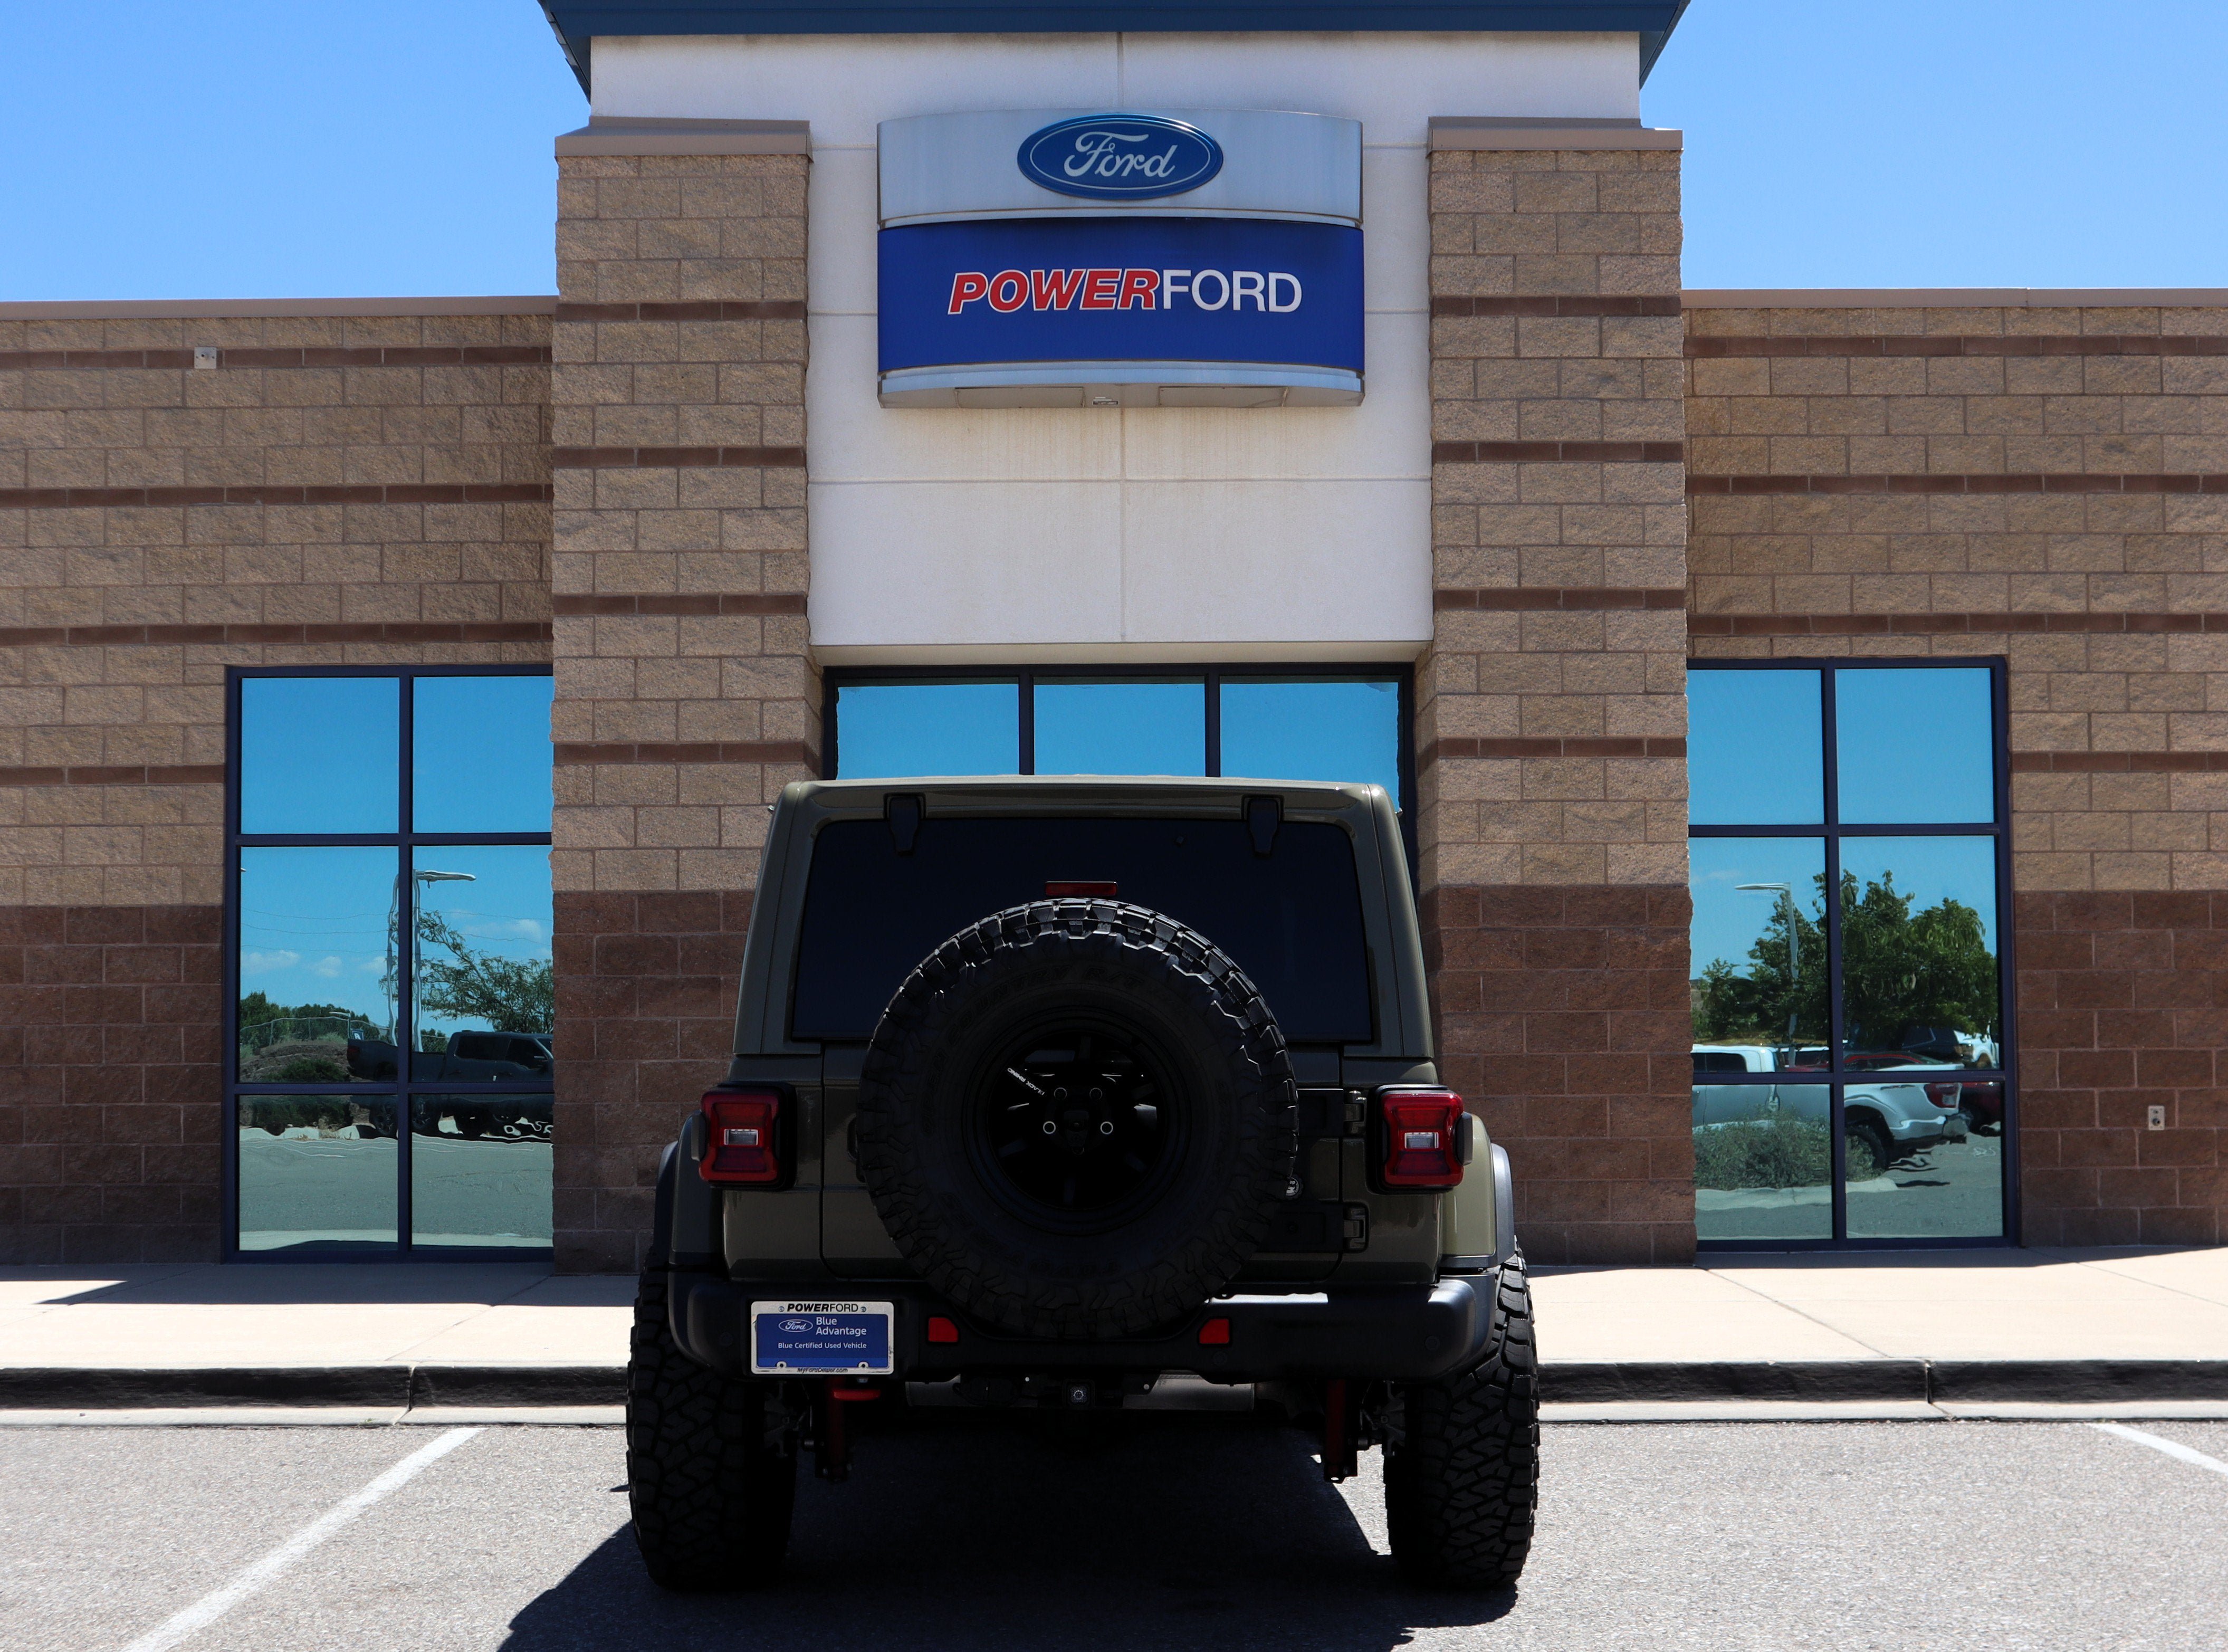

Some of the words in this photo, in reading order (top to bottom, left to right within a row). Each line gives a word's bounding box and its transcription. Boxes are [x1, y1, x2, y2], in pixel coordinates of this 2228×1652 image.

[1064, 131, 1176, 177] Ford
[1007, 1067, 1026, 1082] RHINO
[1026, 1081, 1045, 1095] BLACK
[785, 1321, 807, 1330] Ford
[816, 1327, 867, 1336] Advantage
